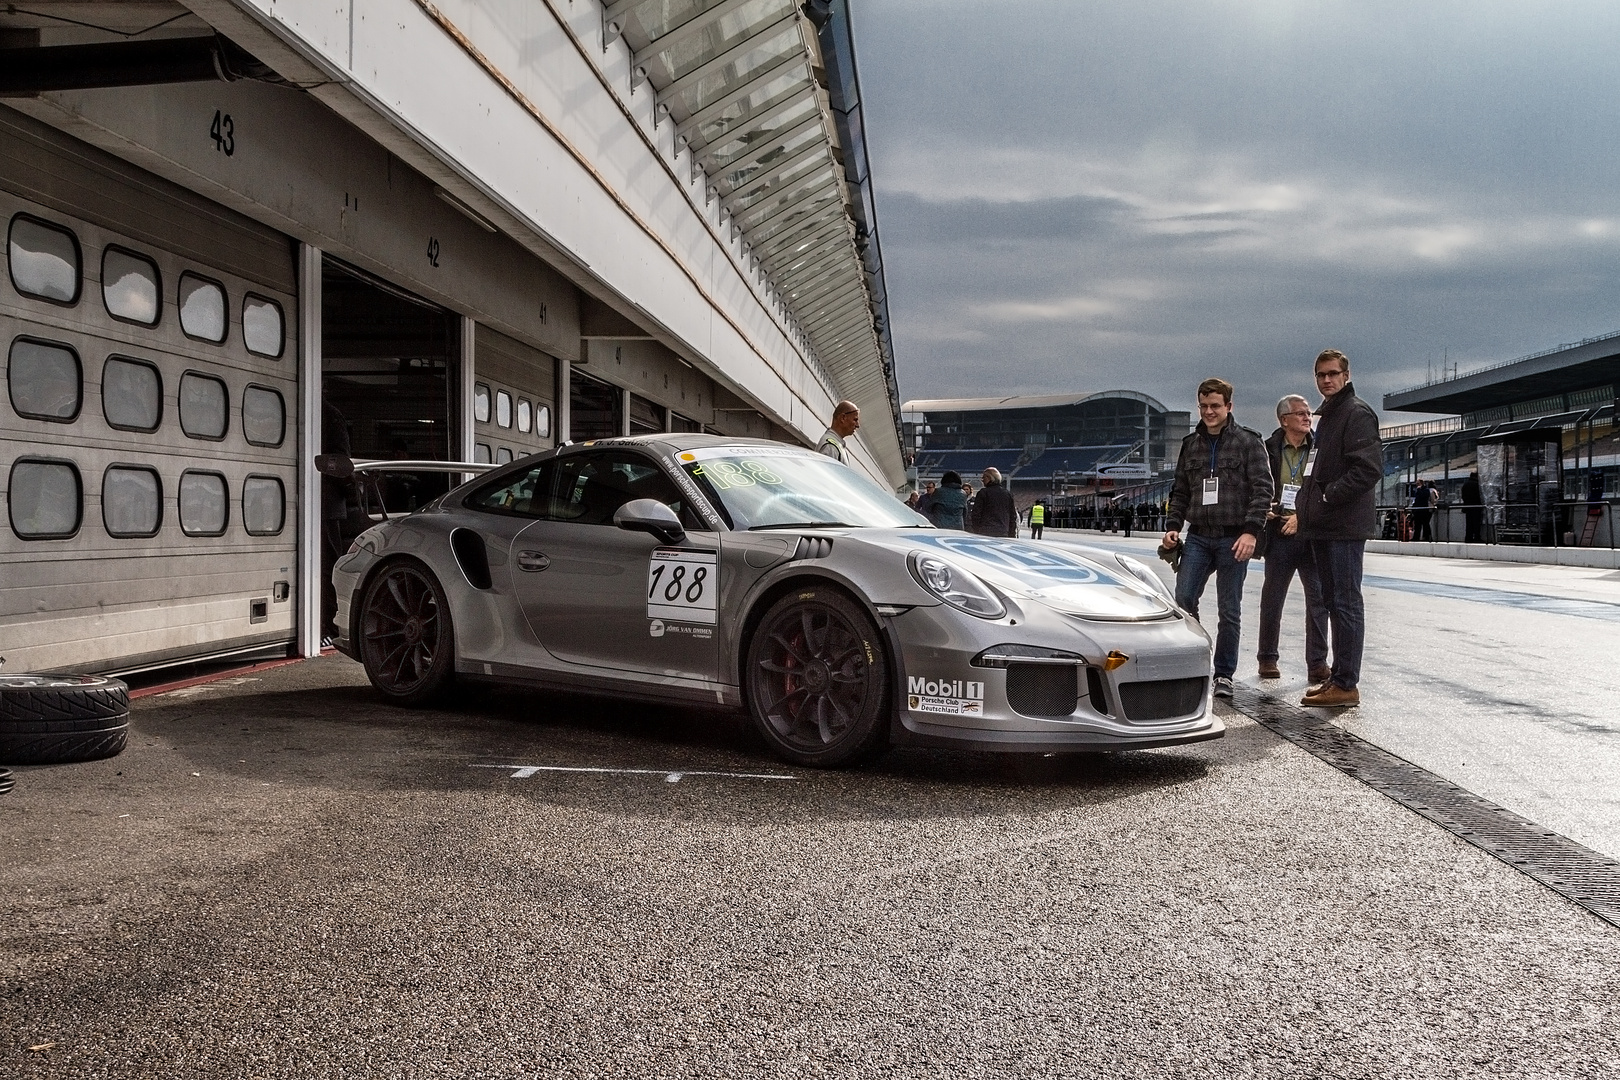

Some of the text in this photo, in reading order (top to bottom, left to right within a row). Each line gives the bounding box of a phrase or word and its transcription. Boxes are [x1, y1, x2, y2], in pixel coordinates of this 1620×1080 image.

[210, 110, 235, 157] 43
[427, 236, 440, 267] 42
[539, 302, 547, 325] 41
[662, 455, 718, 525] www.porschesportscup.de
[692, 460, 783, 490] 188
[649, 565, 707, 603] 188
[908, 676, 963, 698] Mobil
[921, 705, 959, 714] Deutschland
